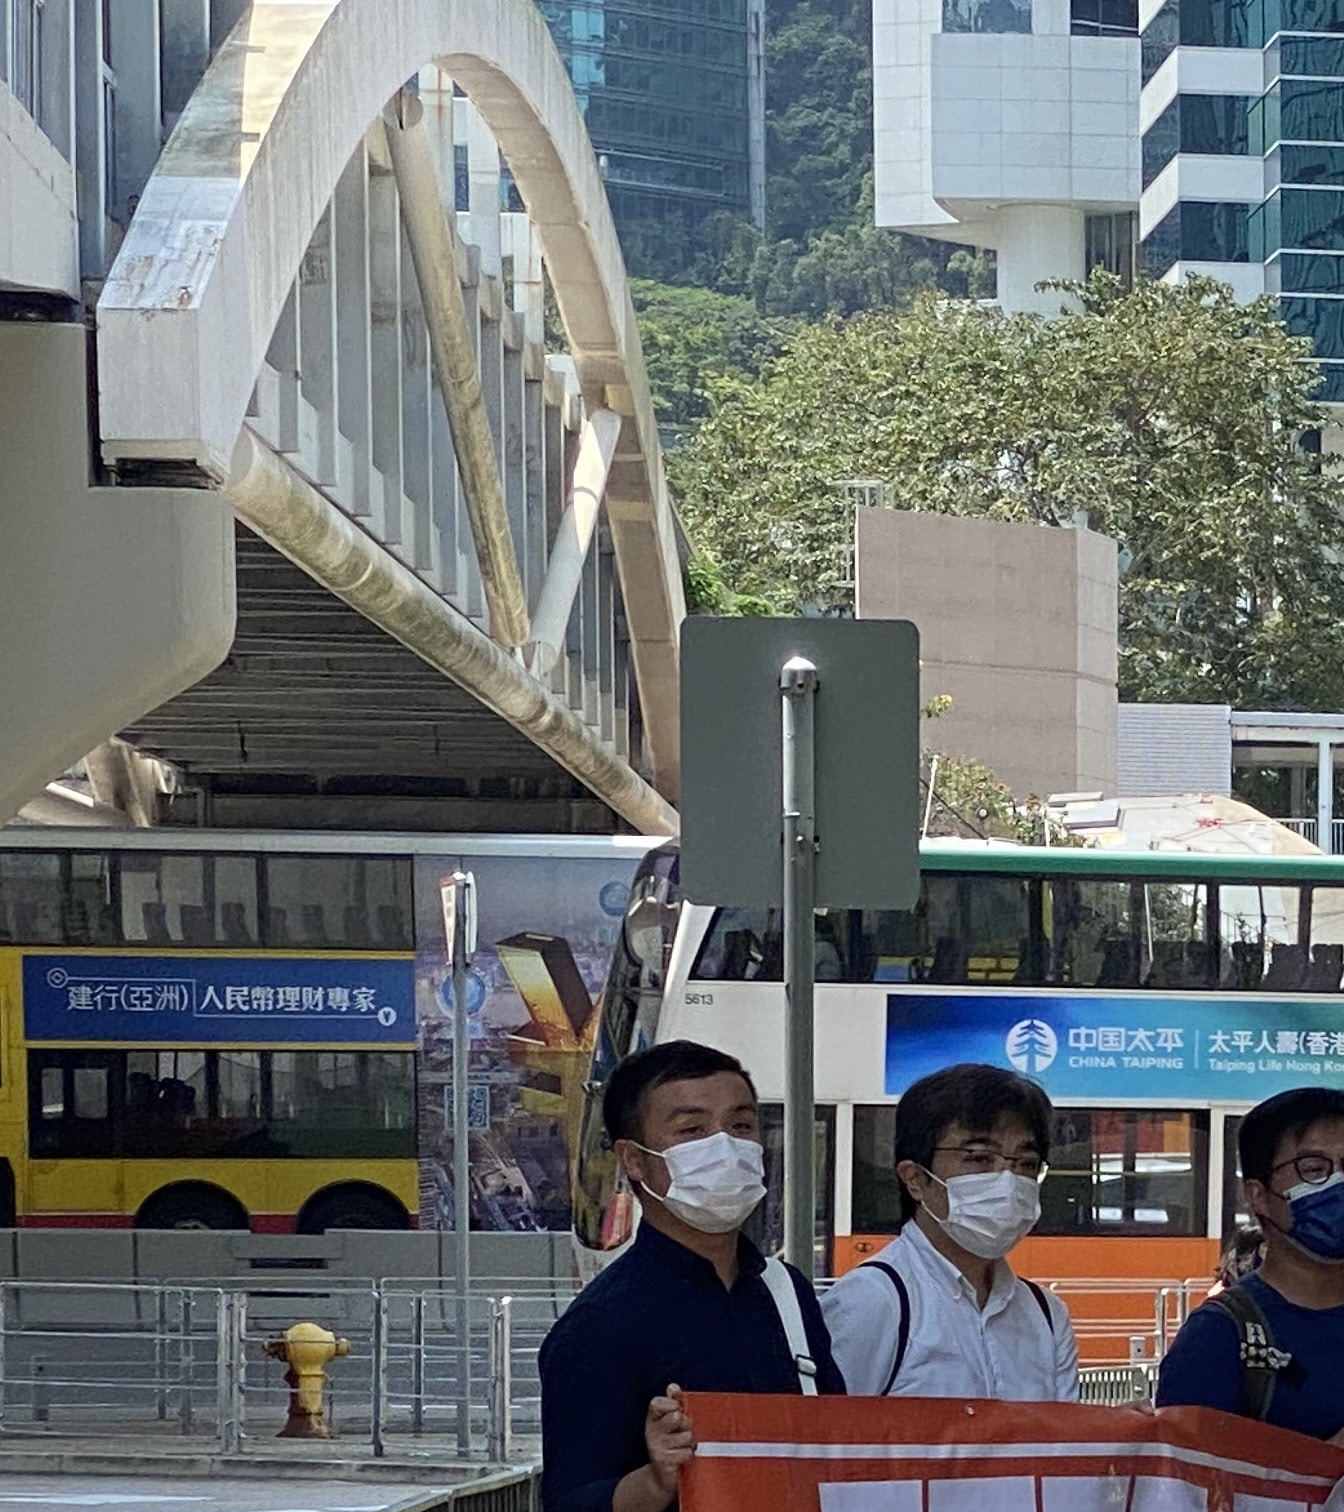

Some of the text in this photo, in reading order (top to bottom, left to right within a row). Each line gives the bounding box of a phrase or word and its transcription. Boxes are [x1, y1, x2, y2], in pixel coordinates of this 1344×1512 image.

[67, 985, 377, 1012] 建行(亞洲) 人民幣理財專家
[1068, 1027, 1185, 1053] 中国太平
[1068, 1056, 1185, 1070] CHINA TAIPING
[1208, 1058, 1256, 1075] Taiping
[1259, 1059, 1283, 1072] Life
[1286, 1060, 1319, 1075] Hong
